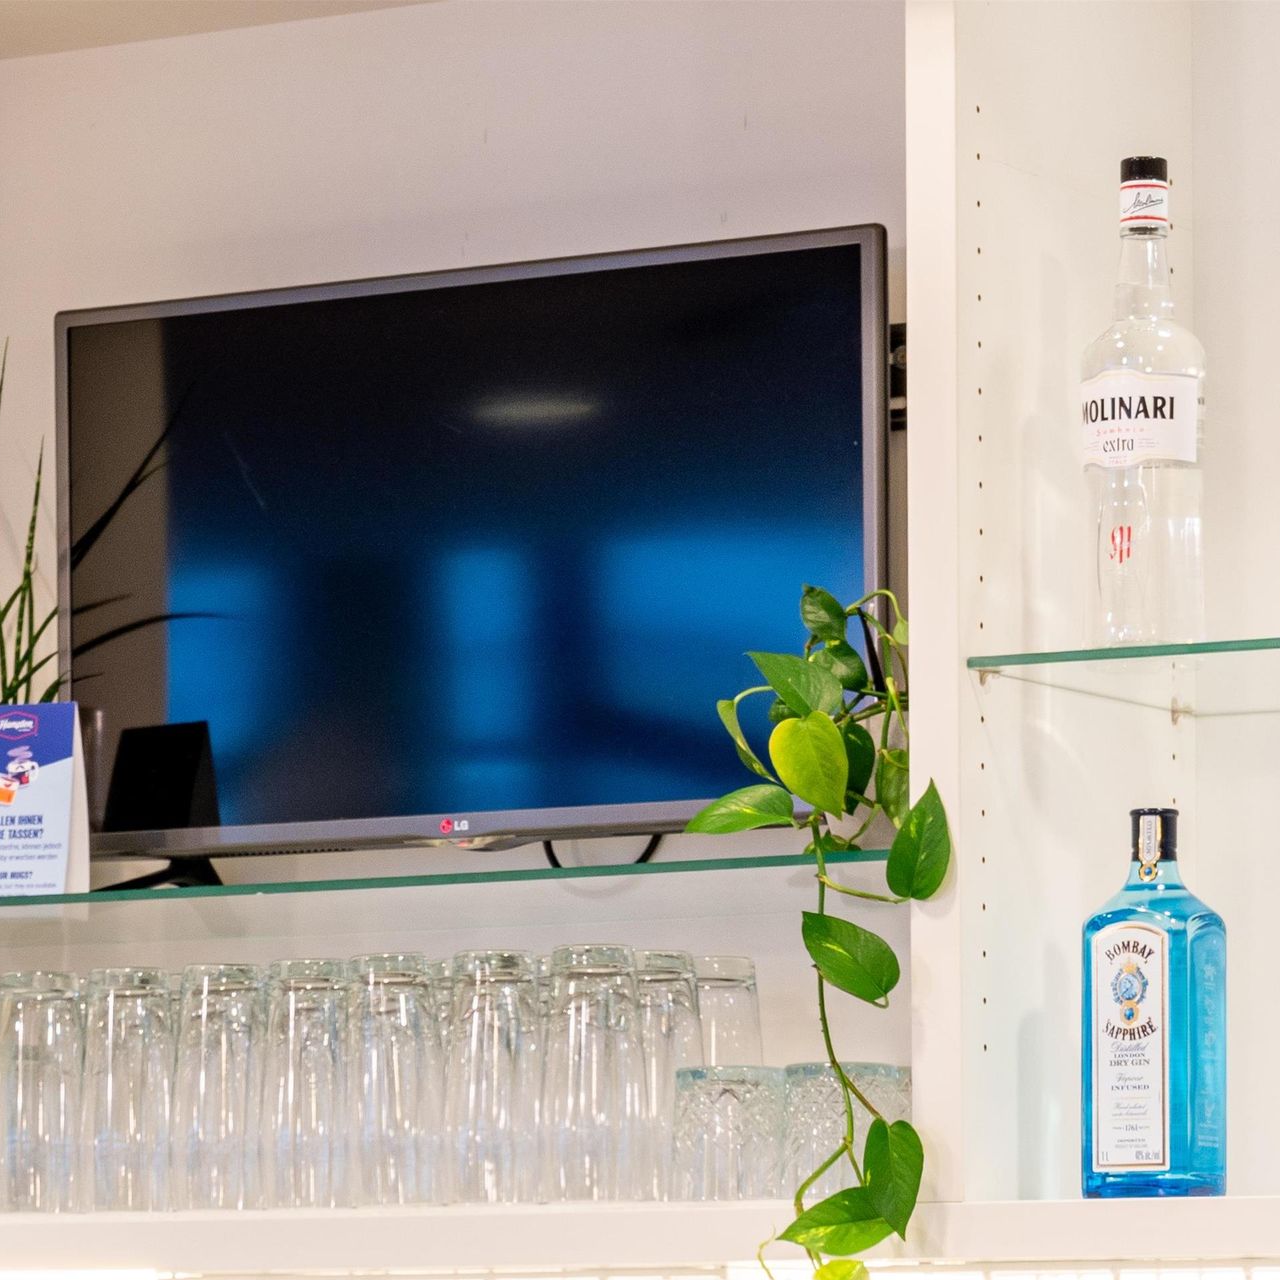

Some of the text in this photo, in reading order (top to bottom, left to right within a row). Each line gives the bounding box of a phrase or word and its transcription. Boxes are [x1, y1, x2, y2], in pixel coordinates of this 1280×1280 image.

[1082, 396, 1175, 425] MOLINARI
[1102, 437, 1135, 453] extra
[18, 815, 43, 825] IHNEN
[453, 820, 469, 831] LG
[8, 828, 44, 839] TASSEN?
[10, 871, 33, 879] MUGS?
[1105, 940, 1155, 963] BOMBAY
[1104, 1017, 1158, 1041] SAPPHIRE
[1109, 1059, 1129, 1067] DRY
